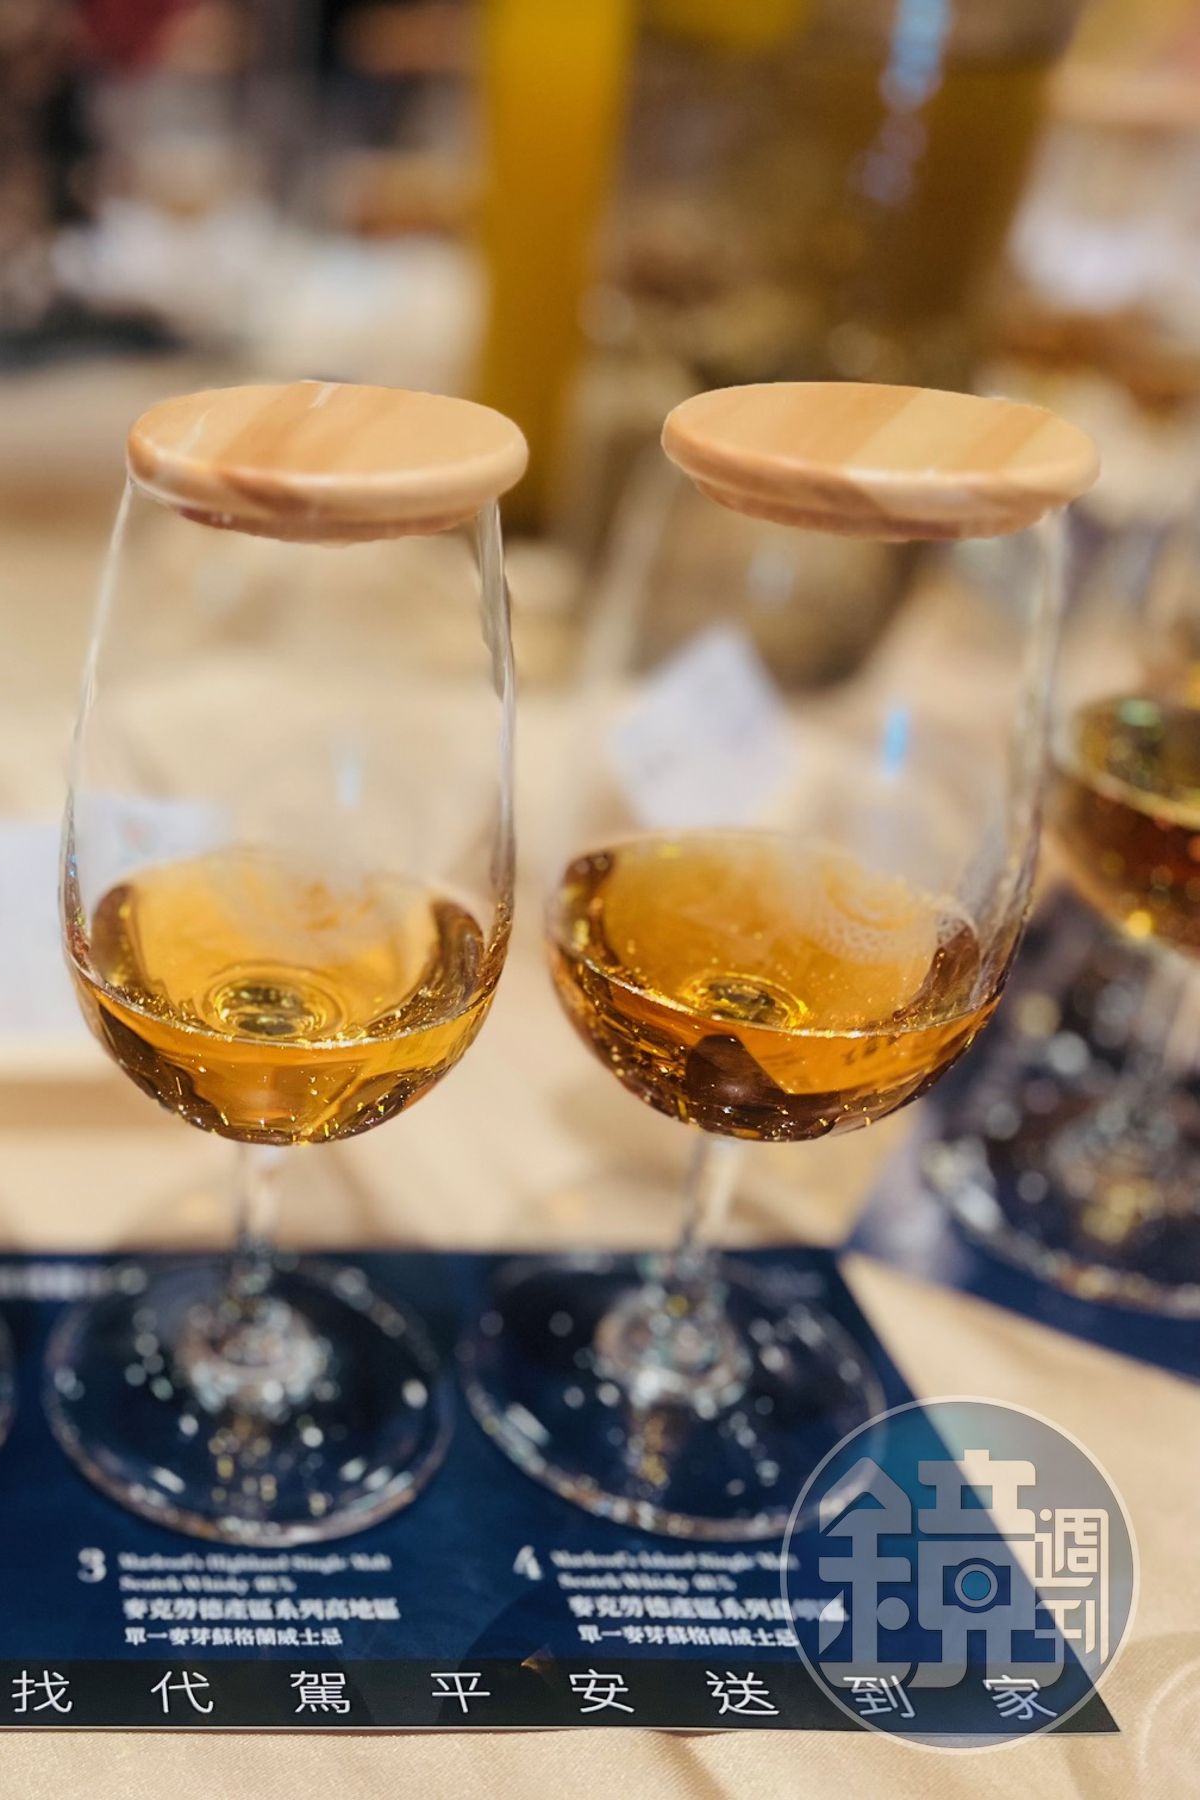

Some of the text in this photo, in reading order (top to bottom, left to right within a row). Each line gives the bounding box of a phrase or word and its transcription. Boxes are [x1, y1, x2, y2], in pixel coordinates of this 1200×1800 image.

[77, 1548, 107, 1583] 3
[124, 1626, 344, 1647] 單一麥芽蘇格蘭威士忌
